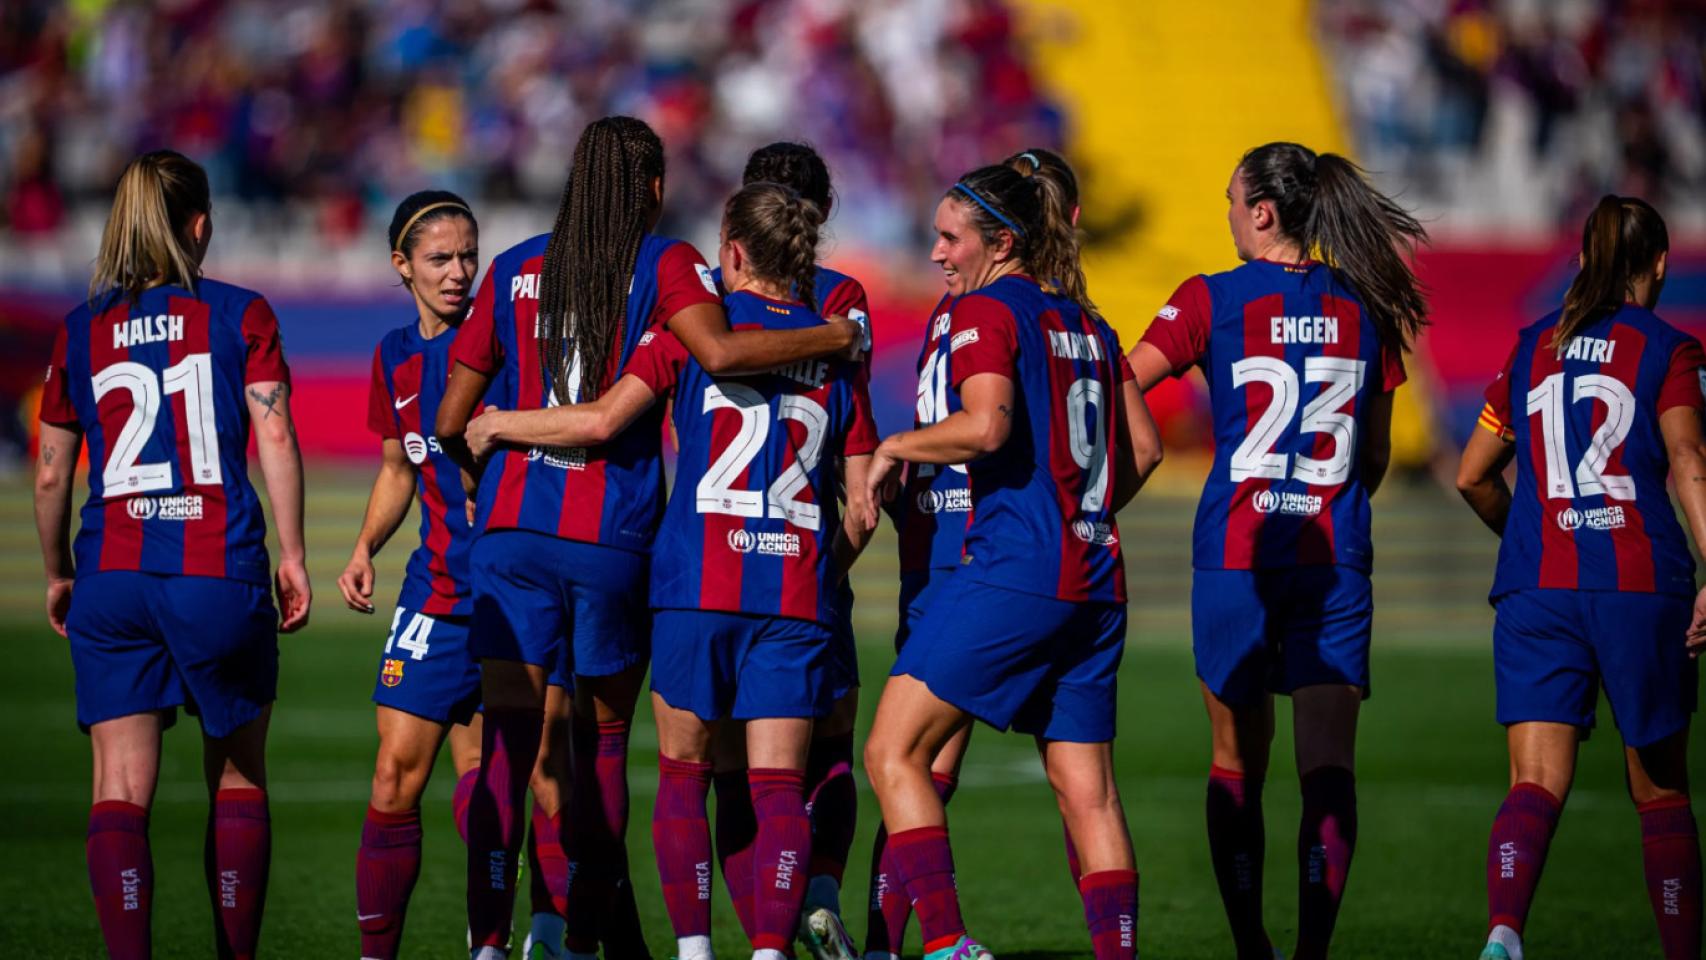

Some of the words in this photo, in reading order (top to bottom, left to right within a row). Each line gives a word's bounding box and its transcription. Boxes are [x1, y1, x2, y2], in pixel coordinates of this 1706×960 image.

[113, 315, 184, 349] WALSH
[1271, 317, 1338, 344] ENGEN
[91, 352, 223, 498] 21
[1230, 355, 1366, 486] 23
[1527, 372, 1636, 501] 12
[696, 382, 829, 531] 22
[1066, 378, 1109, 512] 9
[159, 495, 203, 507] UNHCR
[159, 506, 203, 516] ACNUR
[945, 488, 971, 498] UNH
[1282, 492, 1322, 505] UNHCR
[1584, 506, 1624, 519] UNHCR
[1585, 514, 1626, 527] ACNUR
[757, 532, 800, 543] UNHCR
[758, 541, 800, 553] ACNUR
[385, 606, 435, 660] 14
[775, 849, 797, 890] BARÇA
[1500, 841, 1517, 879] BARÇA
[121, 867, 141, 911] BARÇA
[221, 870, 240, 908] BARÇA
[695, 860, 711, 900] BARÇA
[1663, 878, 1682, 915] BARÇA
